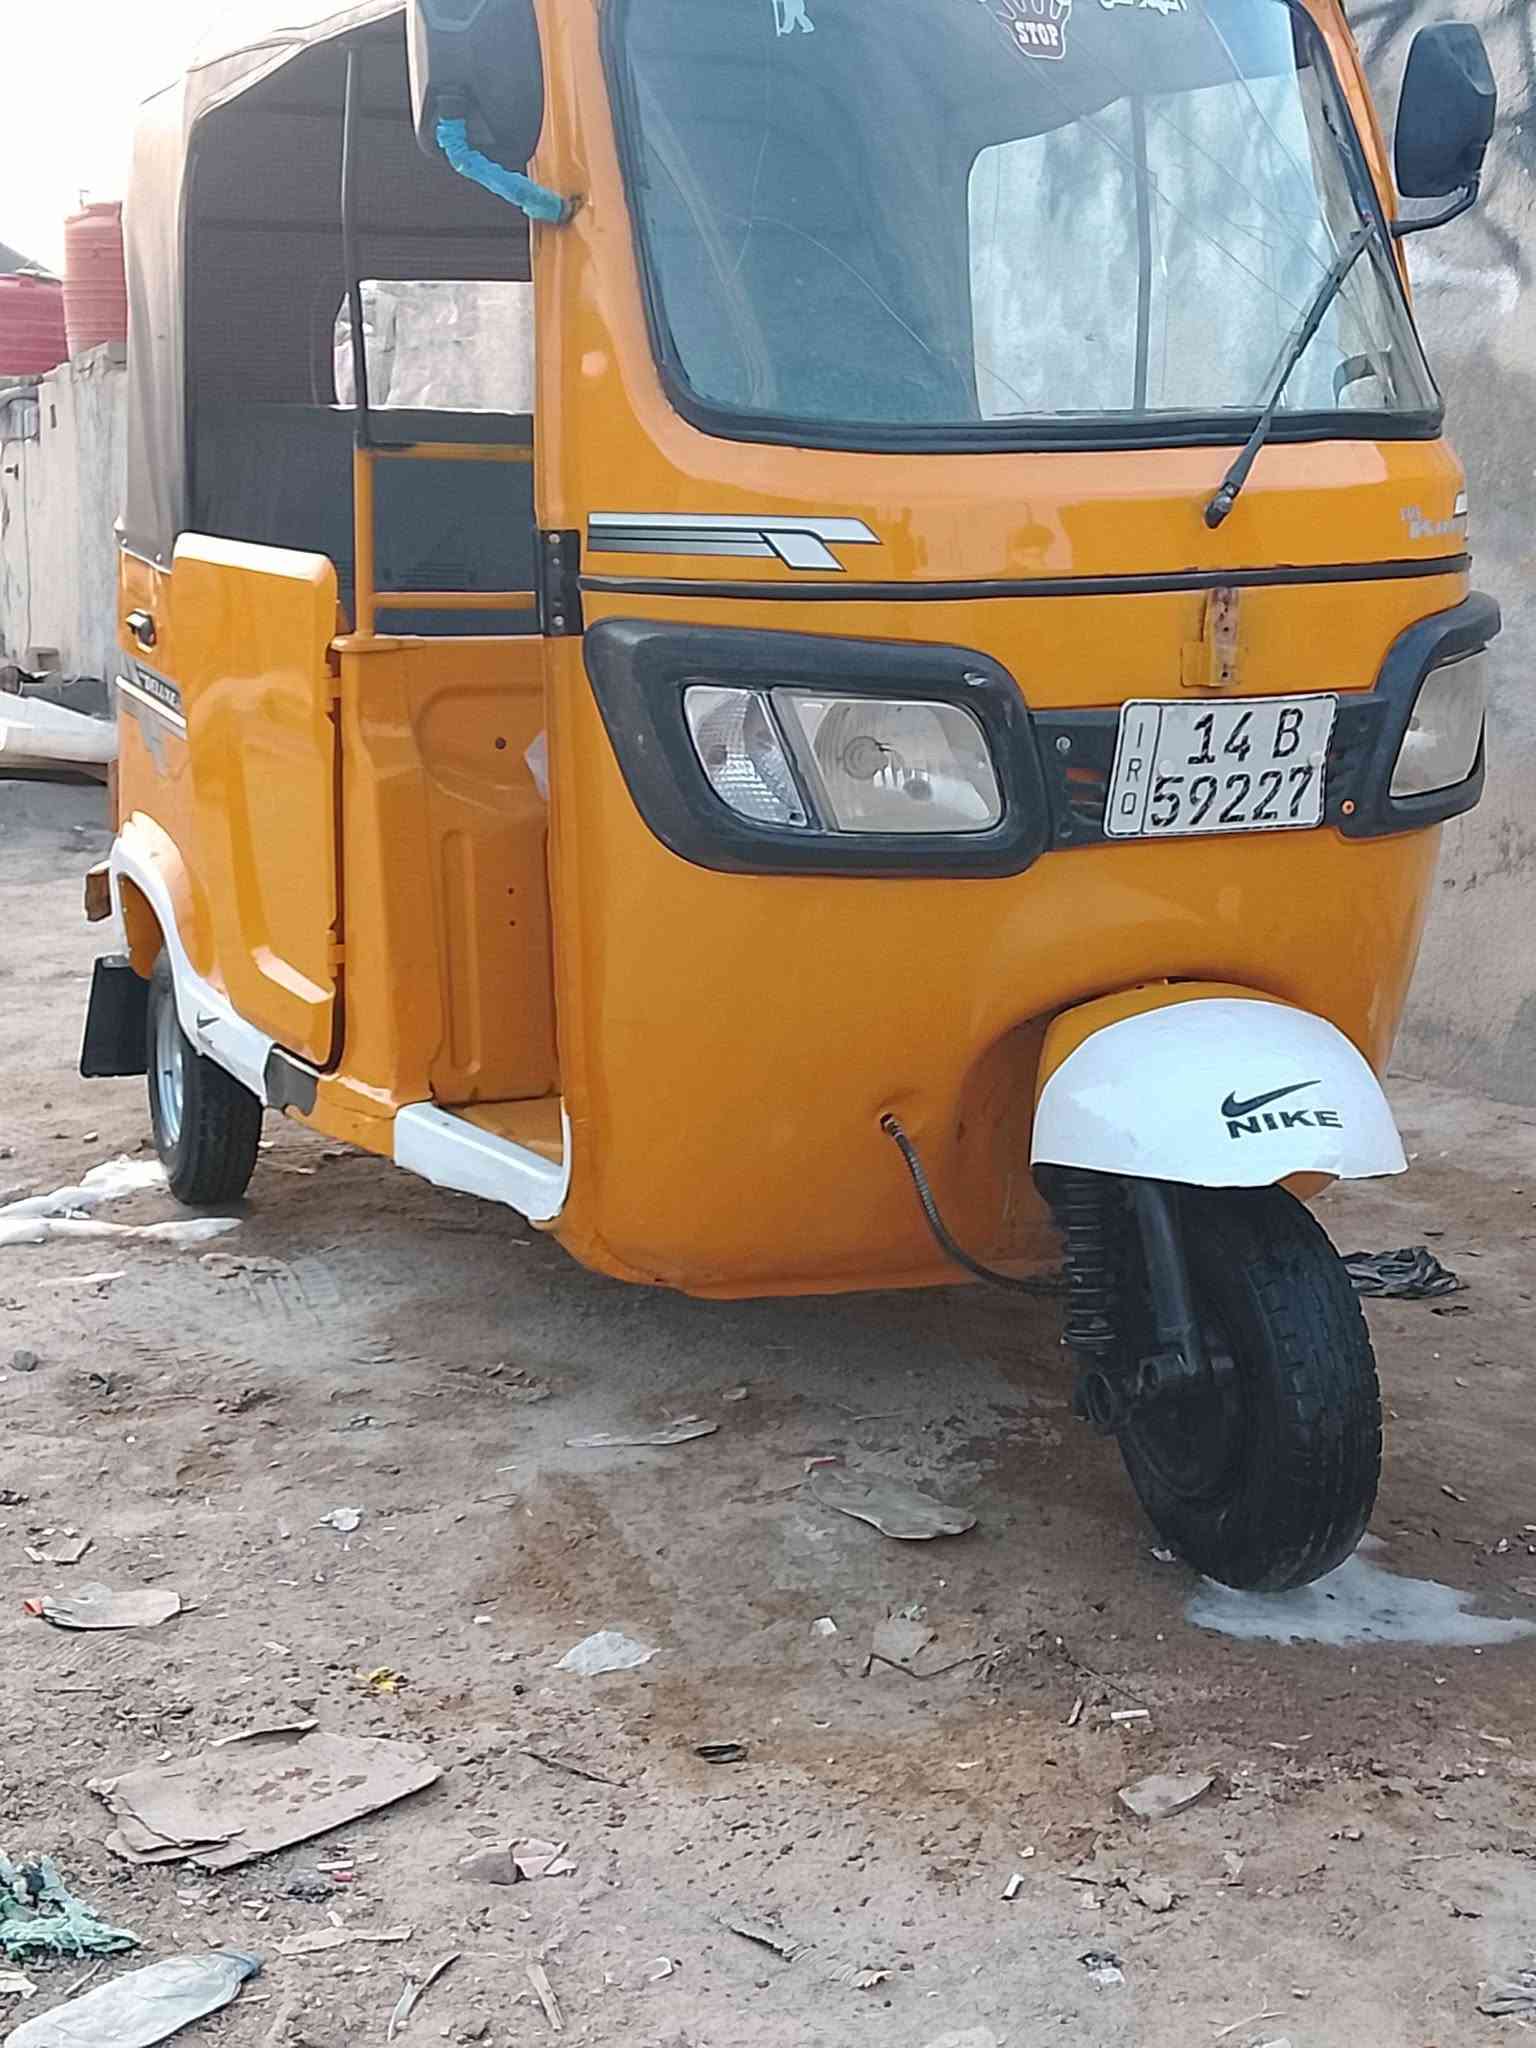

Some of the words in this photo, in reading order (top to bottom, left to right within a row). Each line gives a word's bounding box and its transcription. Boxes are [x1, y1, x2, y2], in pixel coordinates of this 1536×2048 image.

[1014, 21, 1059, 47] STOP
[1187, 711, 1254, 765] 14
[1272, 707, 1304, 759] B
[1151, 766, 1313, 827] 59227
[1225, 1109, 1343, 1139] NIKE
